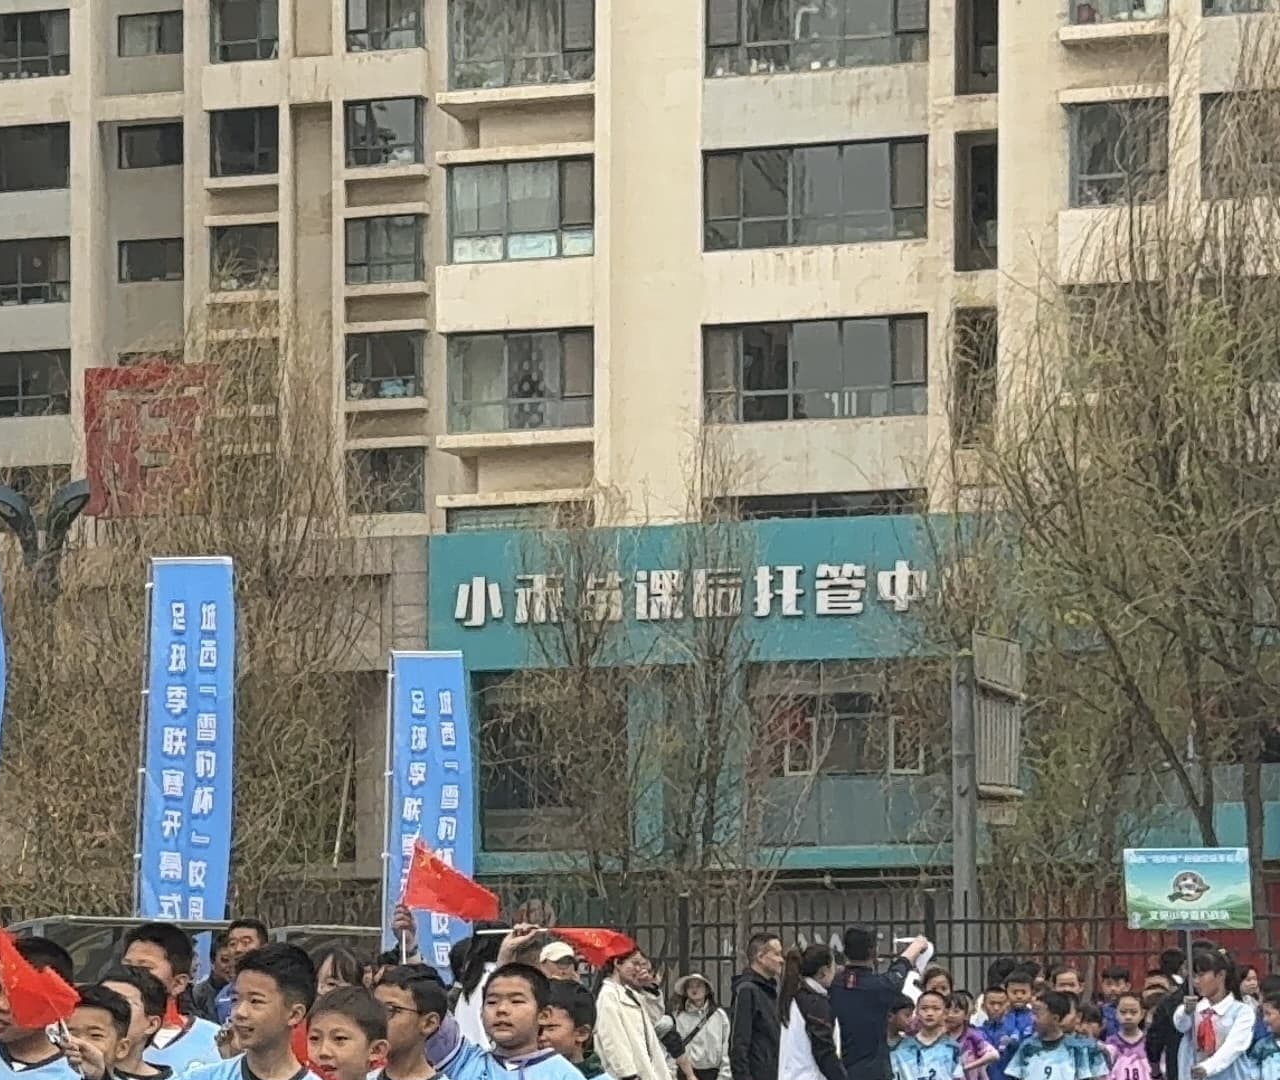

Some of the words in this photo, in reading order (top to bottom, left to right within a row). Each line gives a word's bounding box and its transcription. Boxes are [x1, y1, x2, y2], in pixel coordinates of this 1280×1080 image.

[454, 559, 950, 628] 小禾苗课后托管中
[1044, 1066, 1052, 1079] 9
[1125, 1068, 1139, 1080] 18
